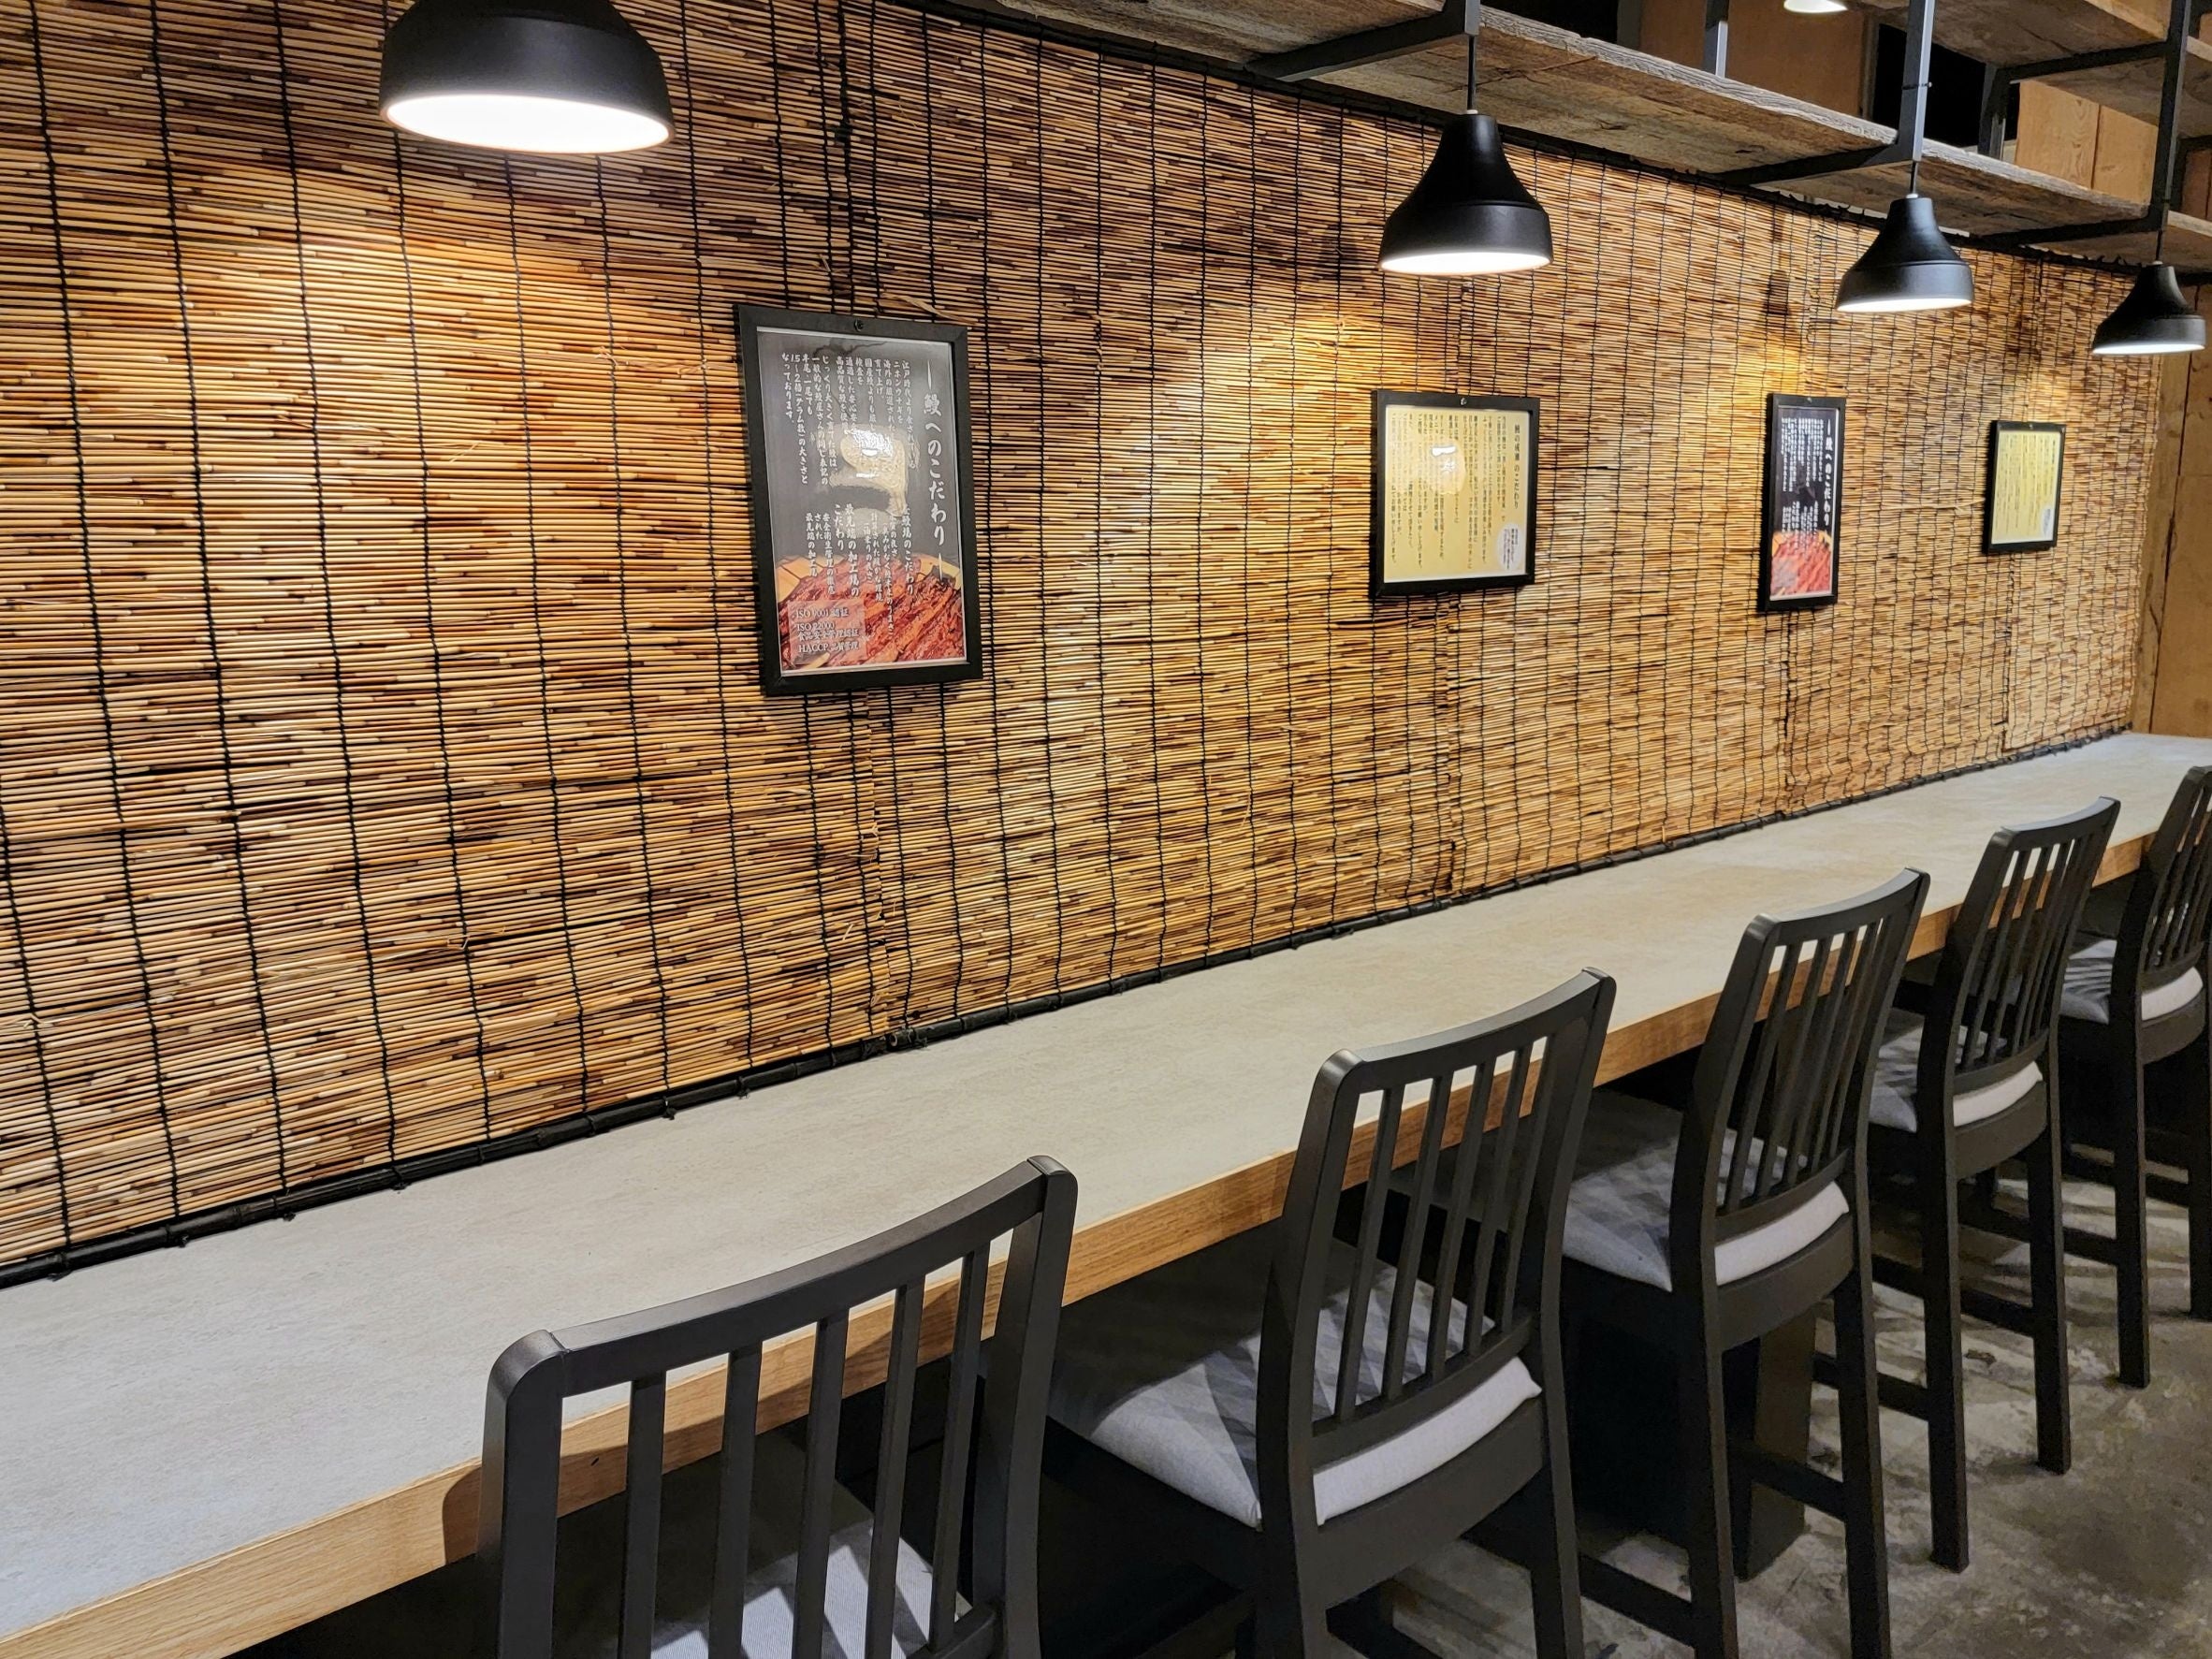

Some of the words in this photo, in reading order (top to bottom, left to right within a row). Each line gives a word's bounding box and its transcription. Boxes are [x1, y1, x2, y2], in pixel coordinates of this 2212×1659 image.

[855, 357, 865, 386] 検査を
[894, 360, 904, 424] ニホンウナギを
[814, 513, 823, 541] された
[834, 503, 845, 551] こだわり
